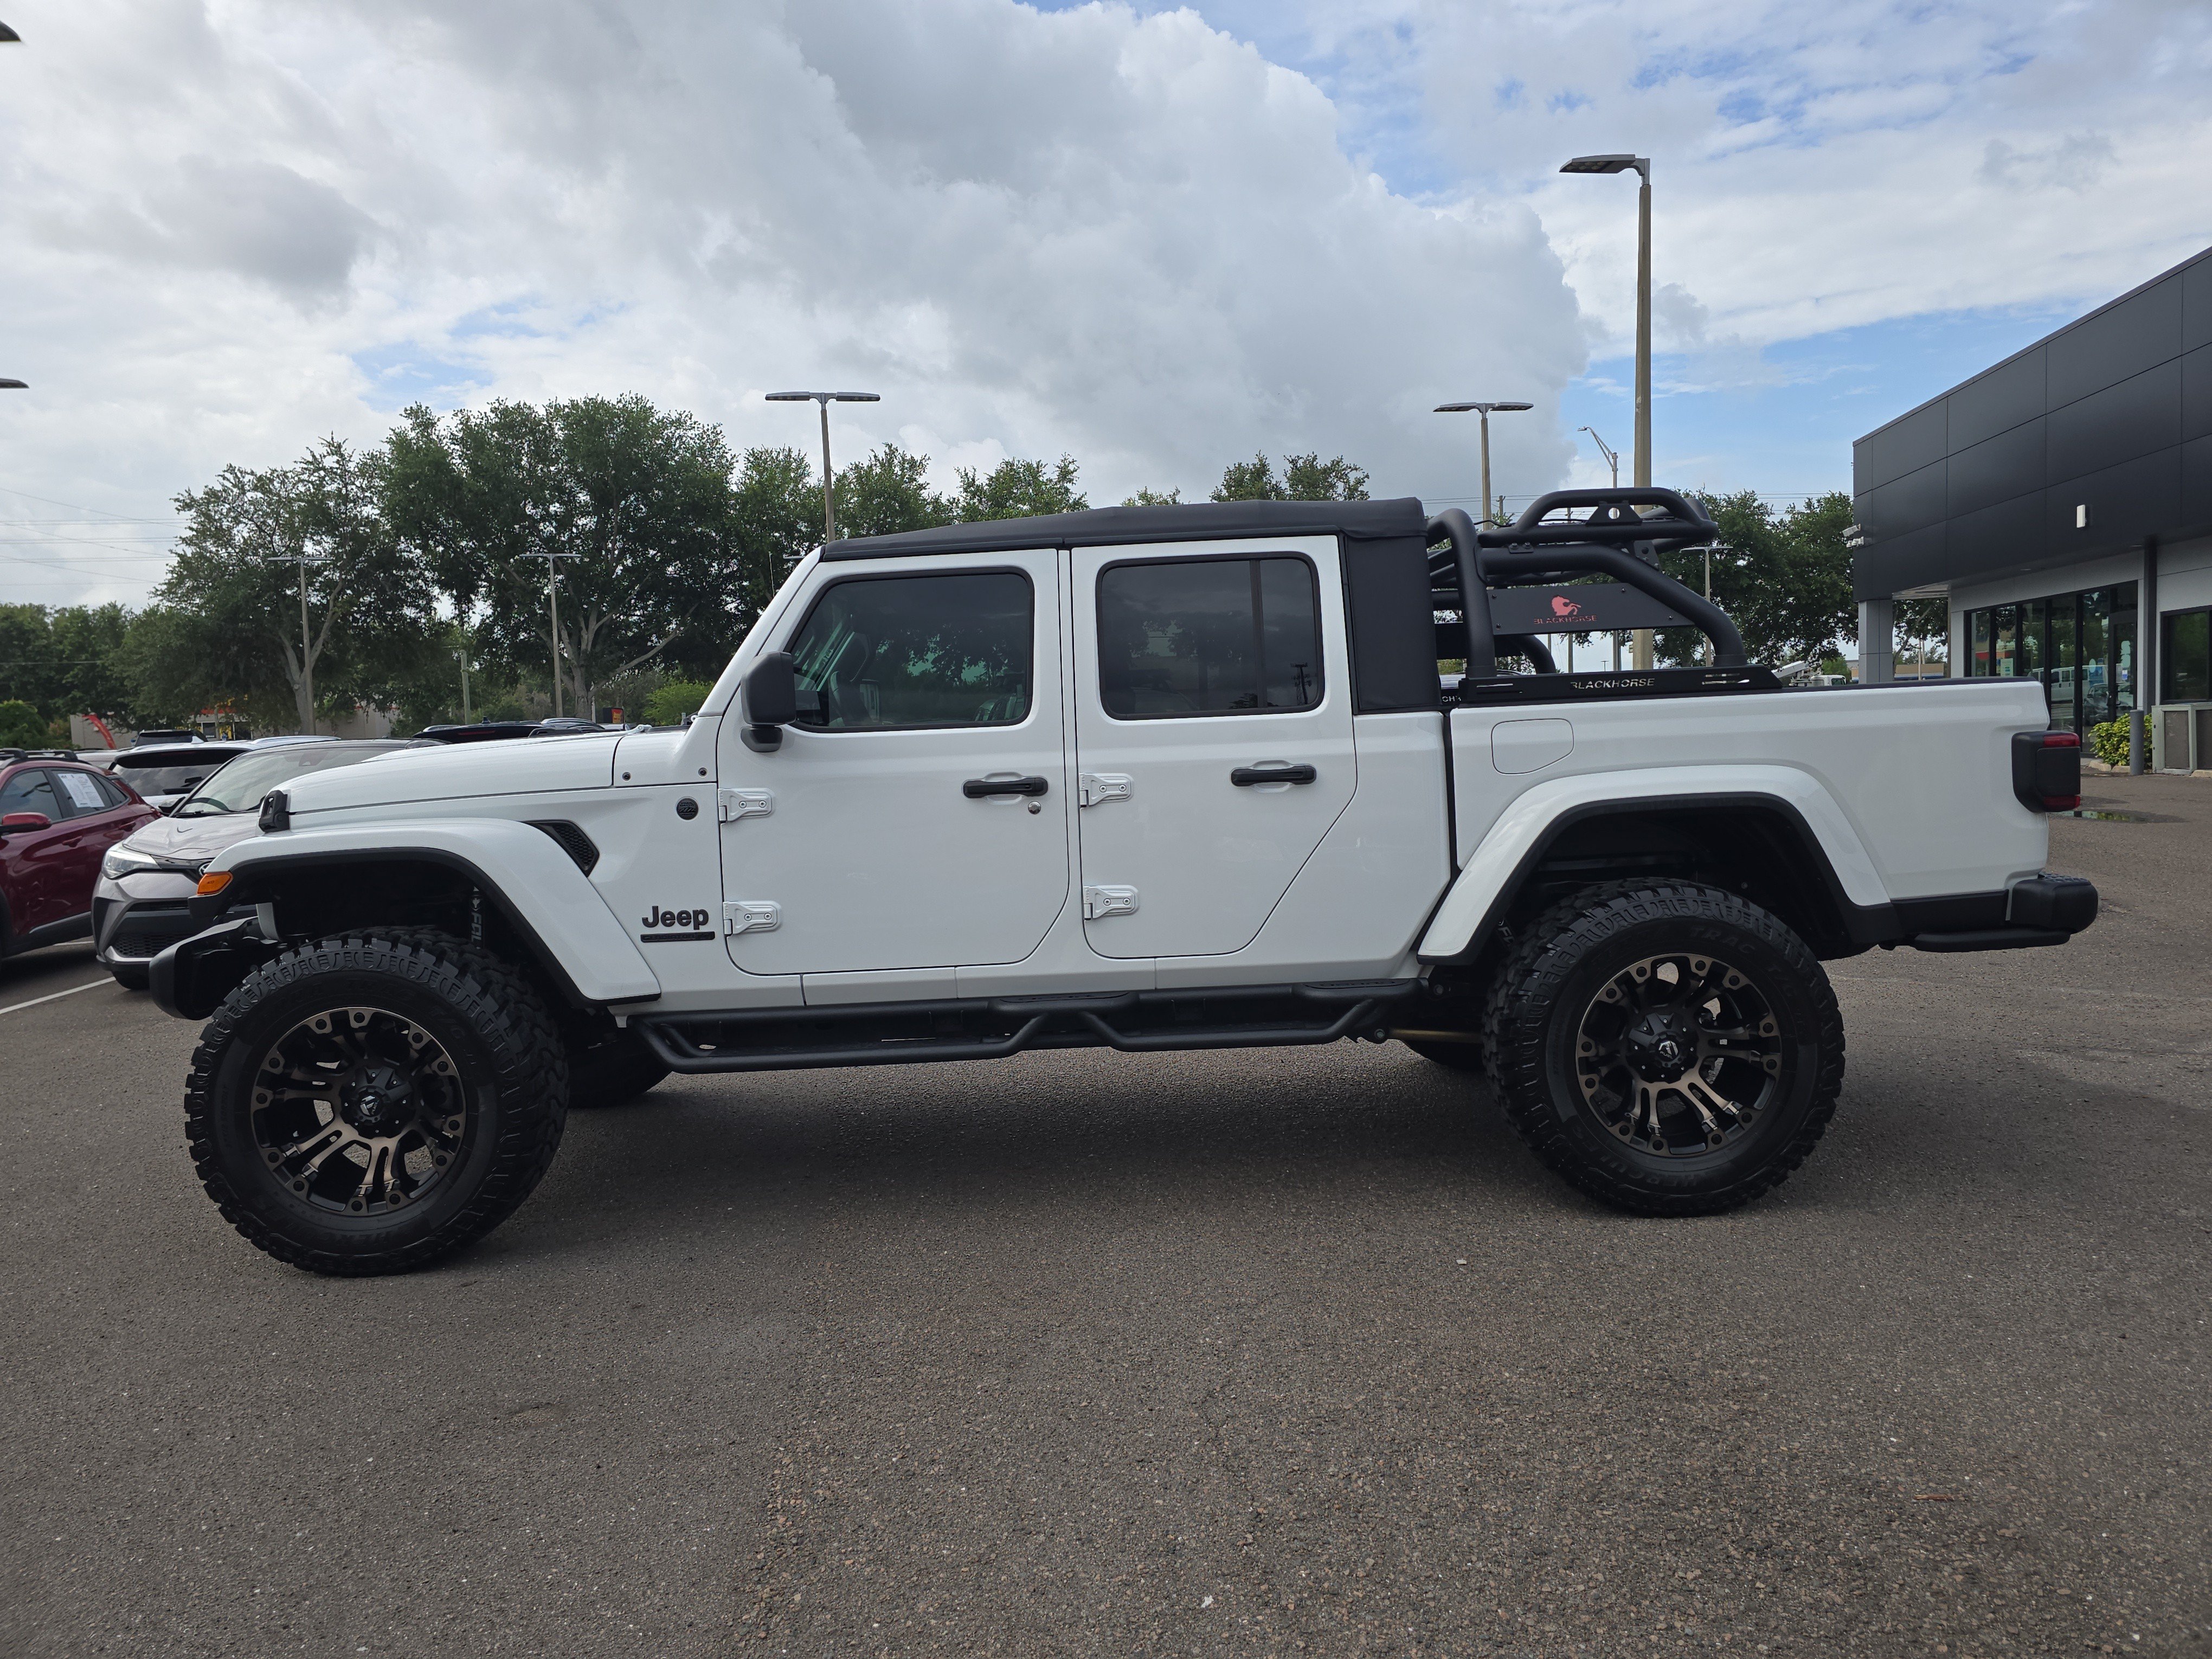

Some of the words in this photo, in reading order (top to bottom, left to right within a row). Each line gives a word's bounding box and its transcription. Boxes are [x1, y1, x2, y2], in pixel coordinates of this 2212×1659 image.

[1534, 615, 1597, 624] BLACKHORSE
[1570, 678, 1655, 689] BLACKHORSE
[642, 906, 709, 930] Jeep
[1688, 925, 1757, 956] TRAC
[1571, 1126, 1699, 1188] HERCULES
